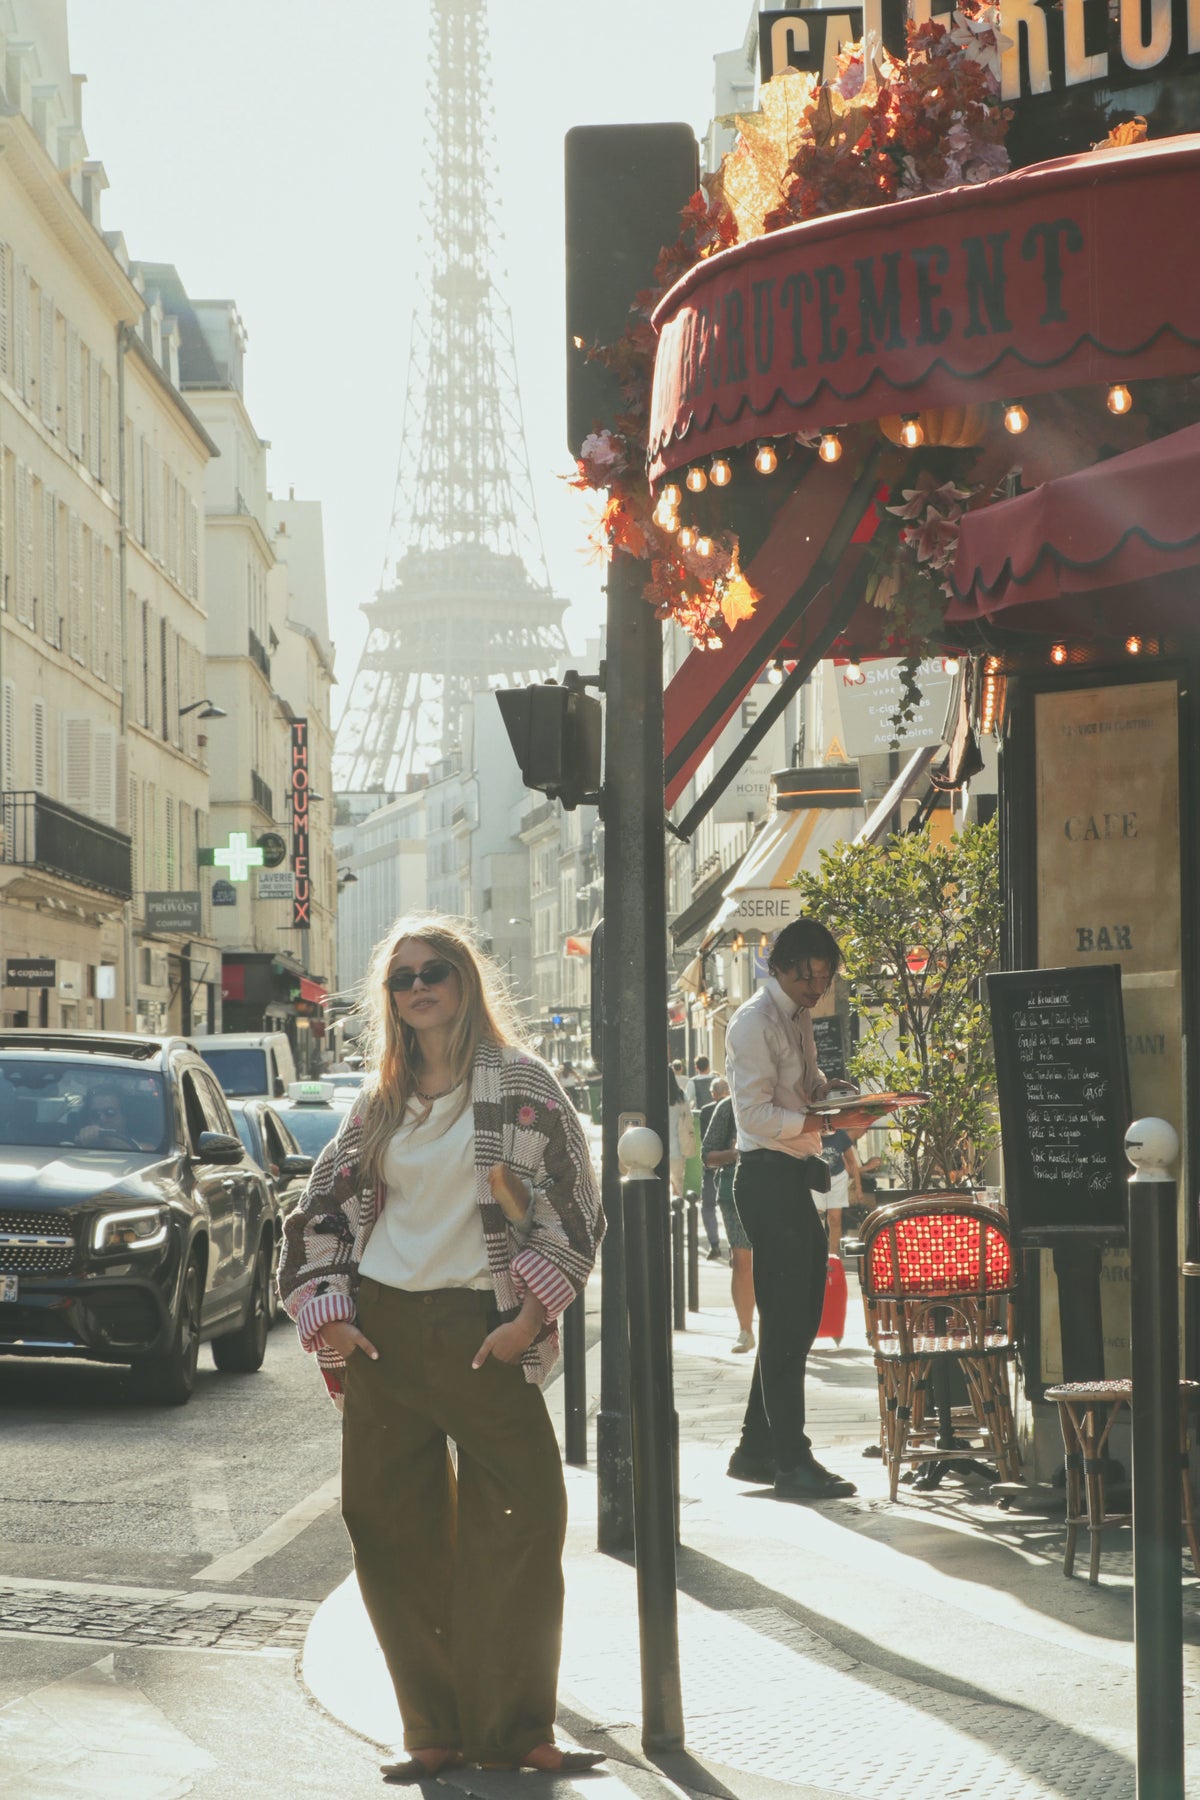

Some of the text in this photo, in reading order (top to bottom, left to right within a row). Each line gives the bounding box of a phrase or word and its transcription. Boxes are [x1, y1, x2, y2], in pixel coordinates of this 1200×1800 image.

[292, 723, 309, 923] THOUMIEUX
[259, 872, 292, 883] LAVERIE
[148, 902, 199, 913] PROVOST
[727, 899, 790, 918] ASSERIE
[1075, 925, 1132, 952] BAR
[17, 969, 55, 979] copains
